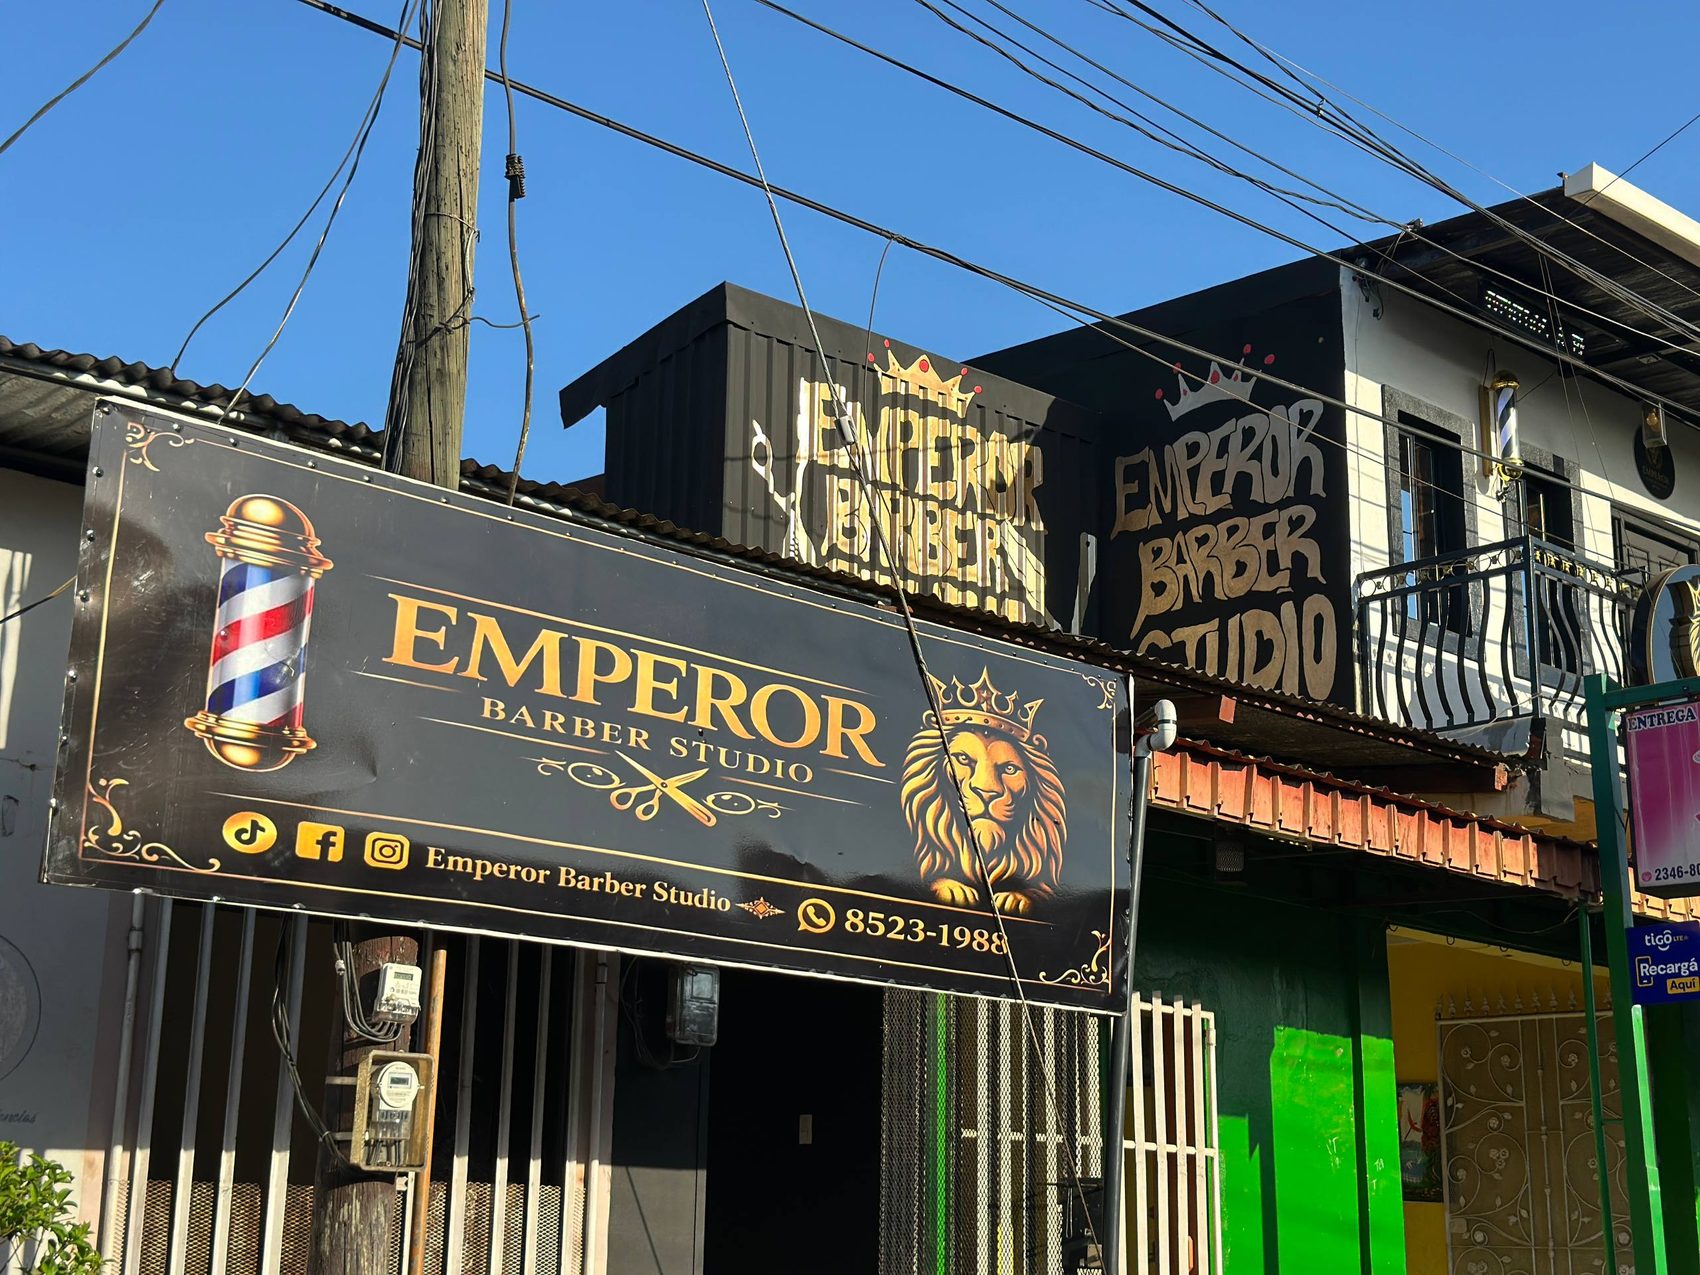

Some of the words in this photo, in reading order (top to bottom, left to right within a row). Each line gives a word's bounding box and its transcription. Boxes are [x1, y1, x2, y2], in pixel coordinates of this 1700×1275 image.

[796, 377, 1048, 534] EMPEROR
[1111, 399, 1326, 540] EMPEROR
[821, 473, 1010, 594] BARBER
[1130, 504, 1326, 640] BARBER
[382, 593, 886, 768] EMPEROR
[1627, 707, 1696, 732] ENTREGA
[481, 696, 650, 751] BARBER
[669, 736, 814, 784] STUDIO
[426, 846, 551, 886] Emperor
[557, 866, 647, 898] Barber
[652, 881, 732, 912] Studio
[844, 908, 1009, 956] 8523-1988
[1639, 957, 1699, 976] Recargá
[1670, 978, 1696, 991] Aquí
